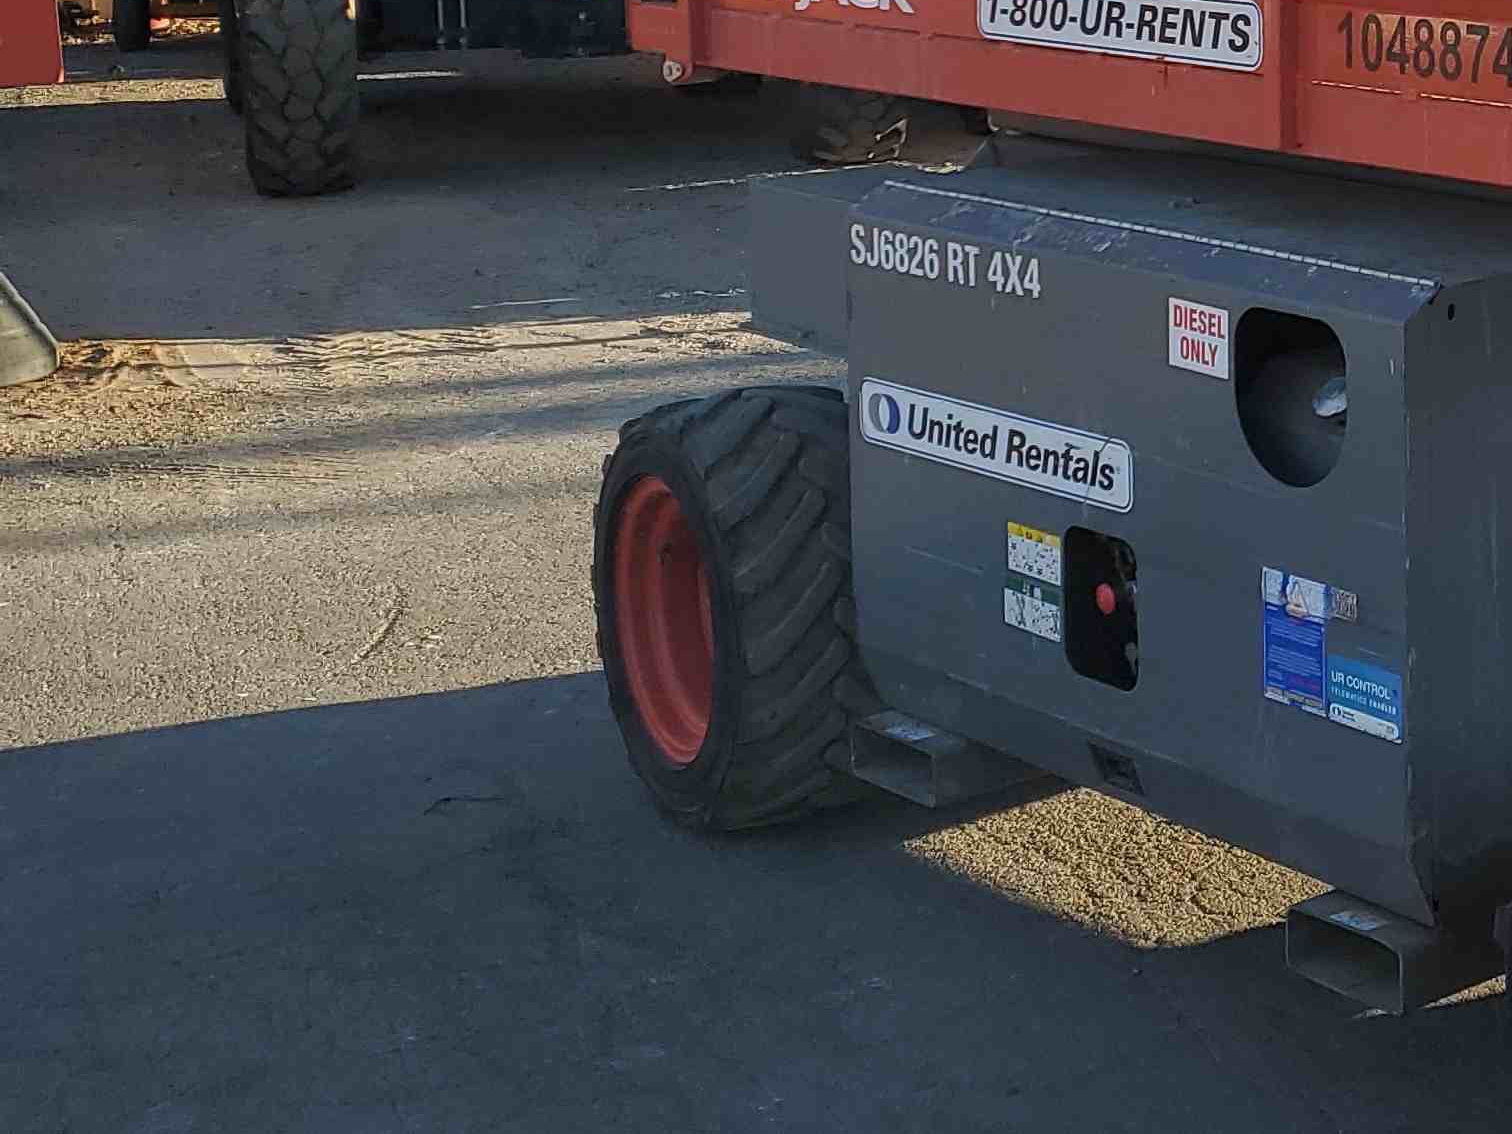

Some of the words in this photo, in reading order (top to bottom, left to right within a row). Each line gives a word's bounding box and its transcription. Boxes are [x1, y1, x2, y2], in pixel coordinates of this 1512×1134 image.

[850, 223, 940, 280] SJ6826
[947, 241, 981, 287] RT
[987, 251, 1042, 299] 4X4
[1173, 304, 1226, 340] DIESEL
[1180, 335, 1219, 368] ONLY
[907, 403, 999, 461] United
[1005, 428, 1115, 491] Rentals
[1331, 669, 1345, 685] UR
[1345, 675, 1391, 700] CONTROL
